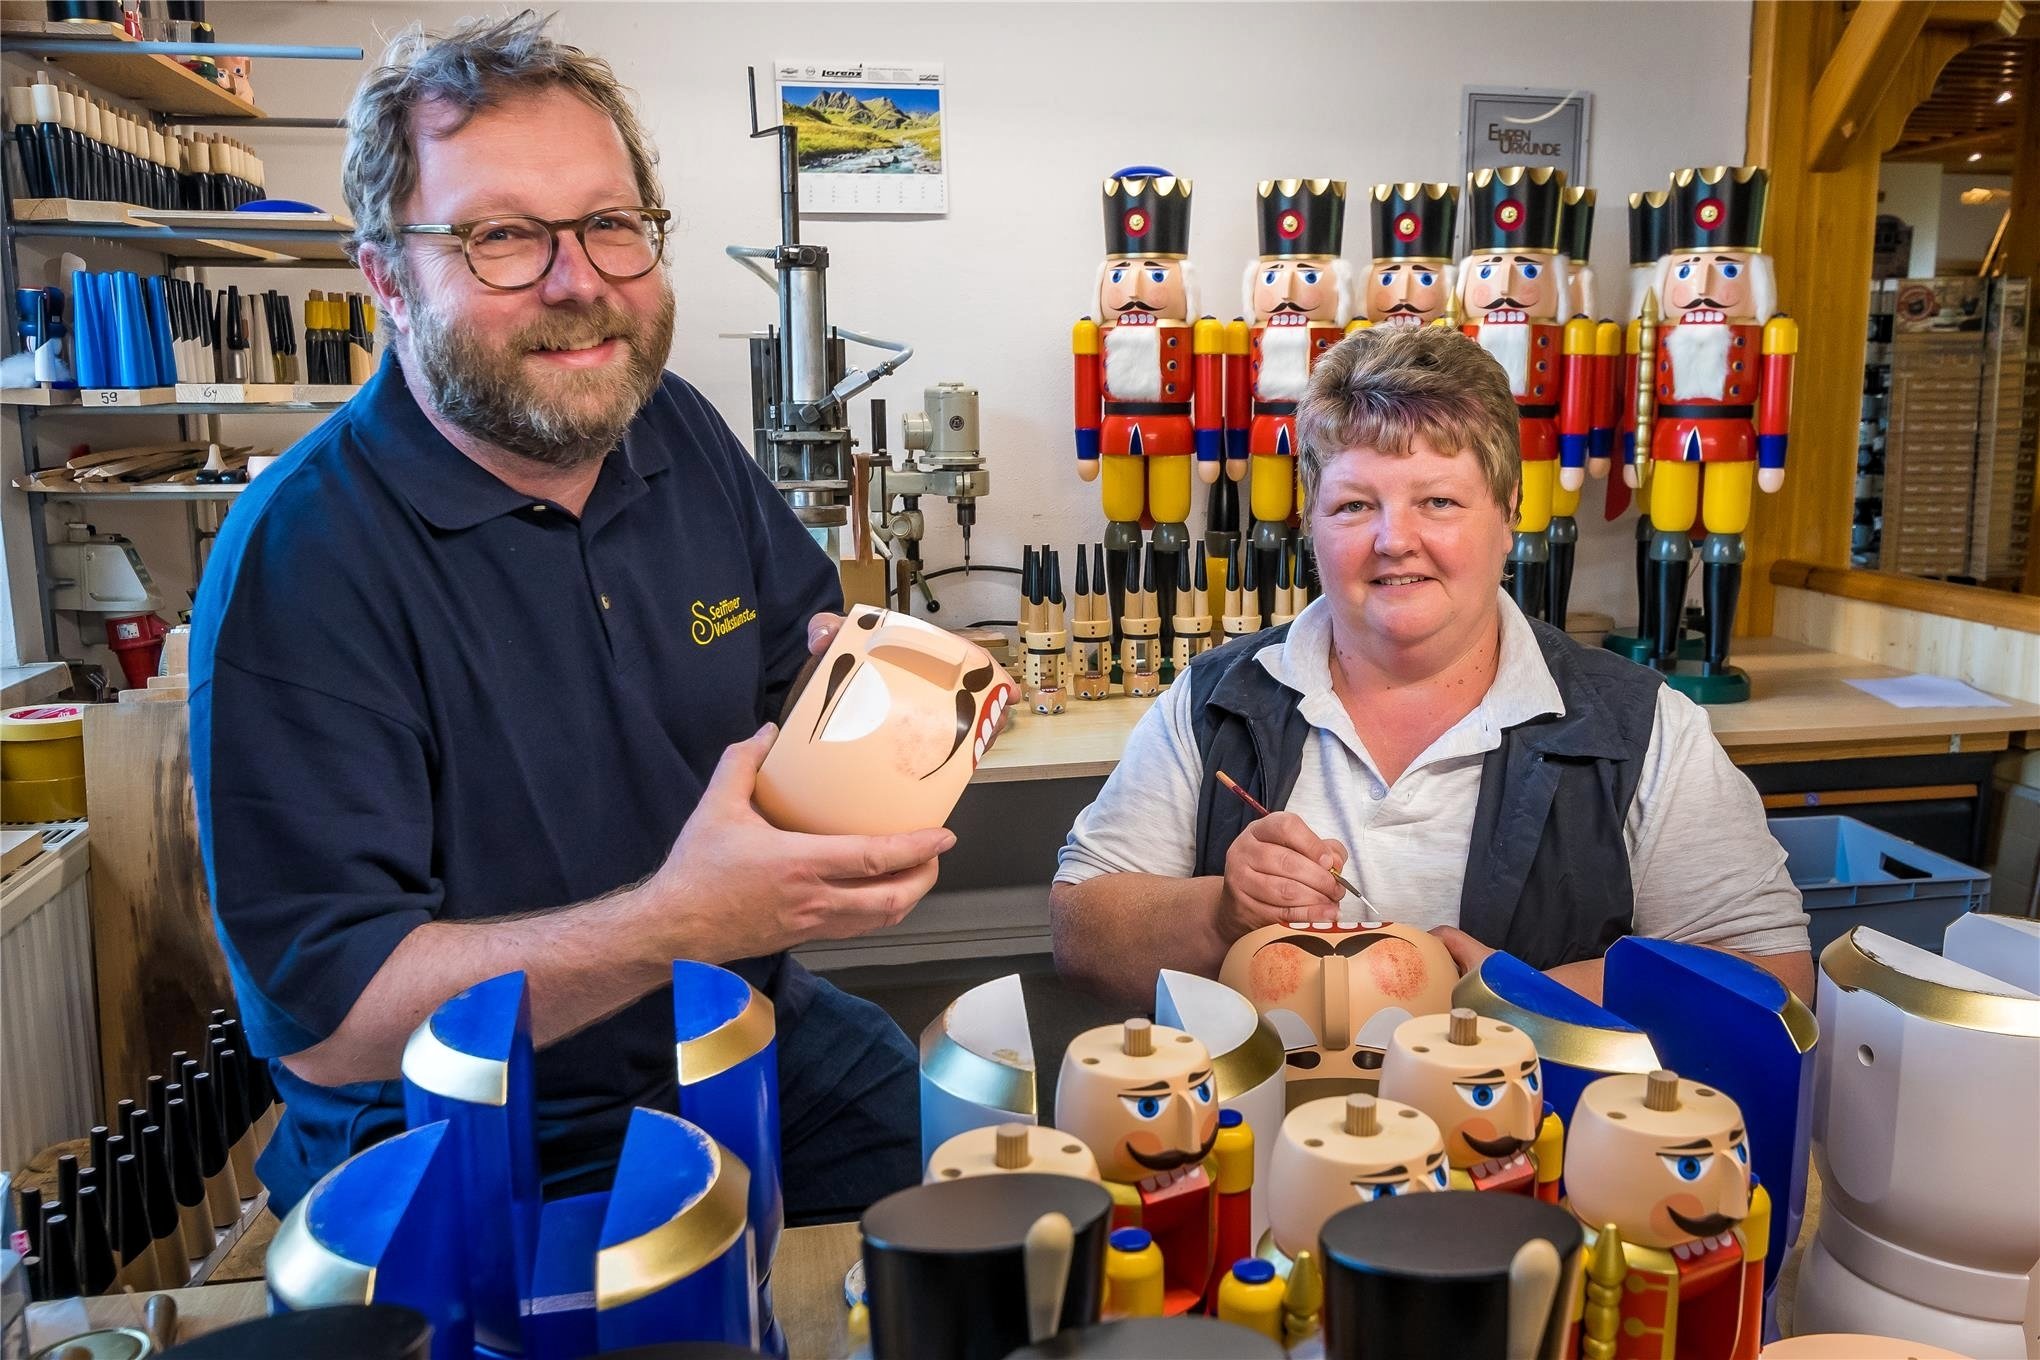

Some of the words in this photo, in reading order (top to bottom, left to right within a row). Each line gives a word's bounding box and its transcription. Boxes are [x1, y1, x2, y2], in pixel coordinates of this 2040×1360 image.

[1488, 123, 1531, 142] EHREN
[1500, 140, 1561, 156] URKUNDE
[101, 391, 118, 404] 59
